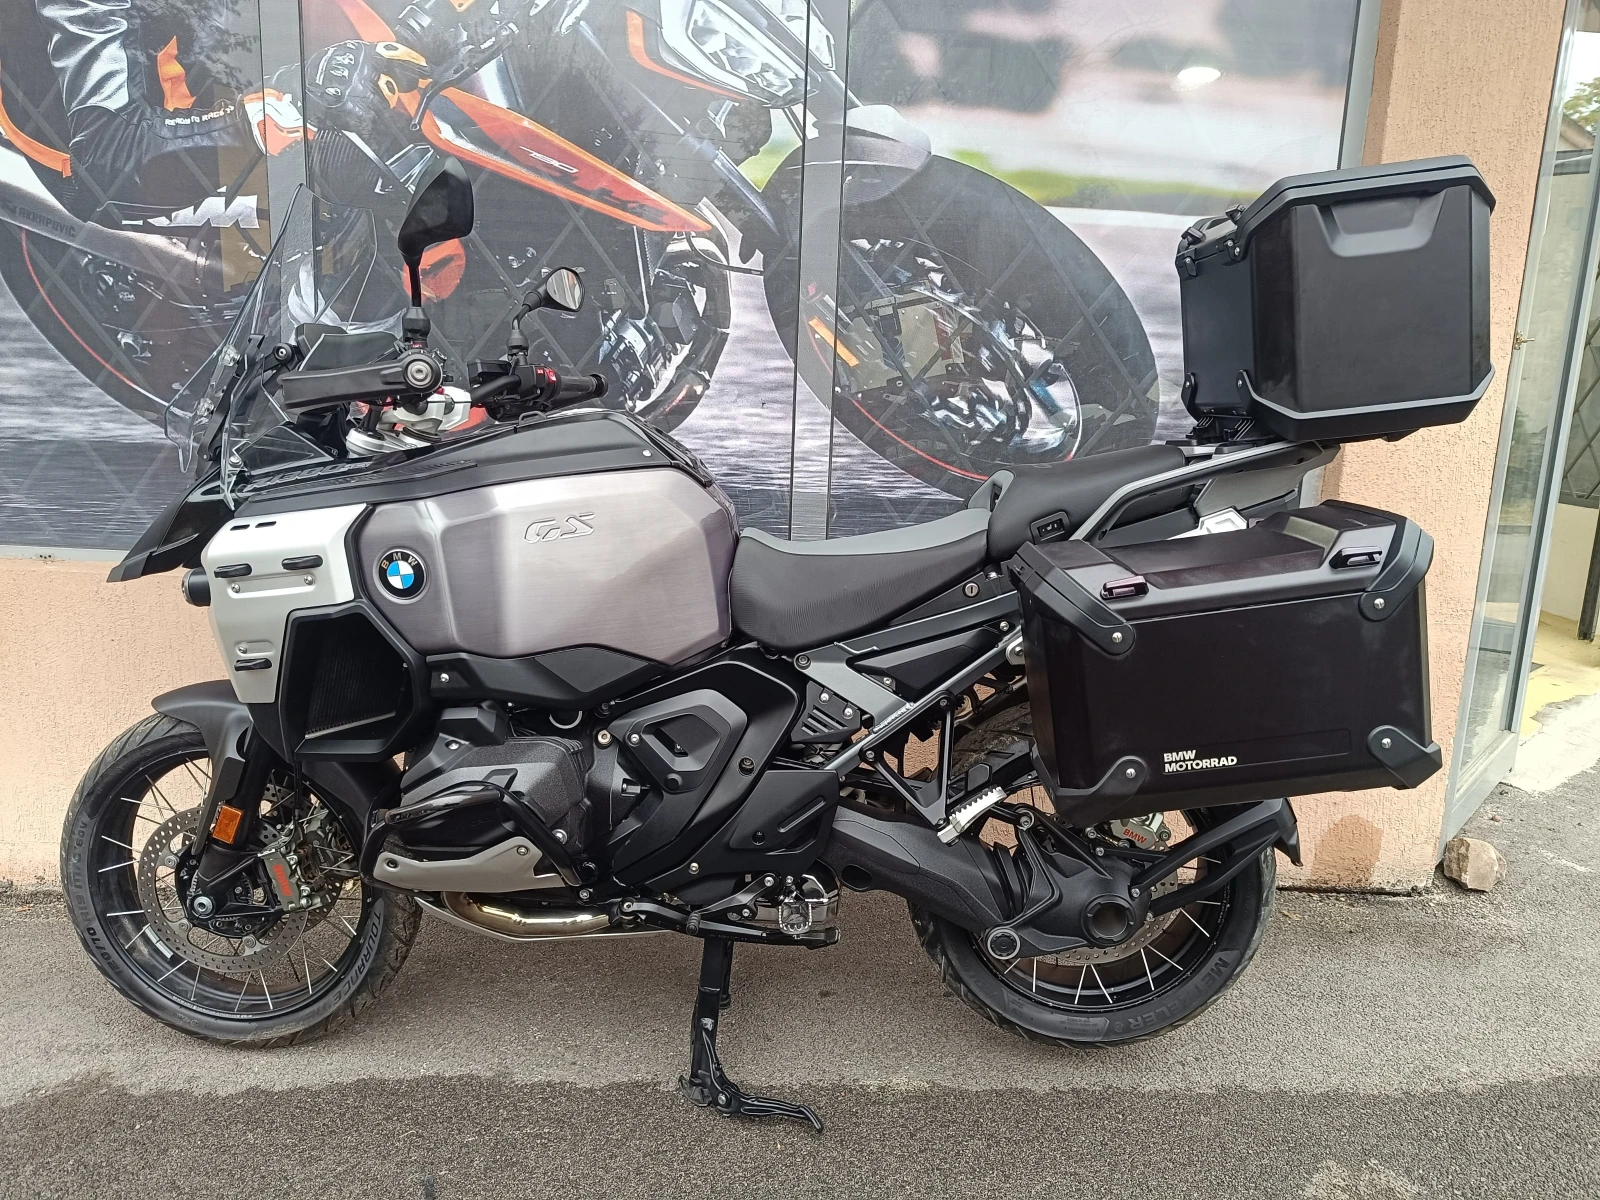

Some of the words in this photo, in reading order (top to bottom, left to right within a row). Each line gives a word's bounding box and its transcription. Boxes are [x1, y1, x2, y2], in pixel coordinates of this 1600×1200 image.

[523, 512, 595, 543] GS
[381, 553, 418, 570] BMW
[1164, 750, 1196, 763] BMW
[1165, 756, 1237, 773] MOTORRAD
[1123, 828, 1147, 844] BMW
[86, 926, 123, 976] 120/70
[332, 910, 382, 1008] TOURANCE
